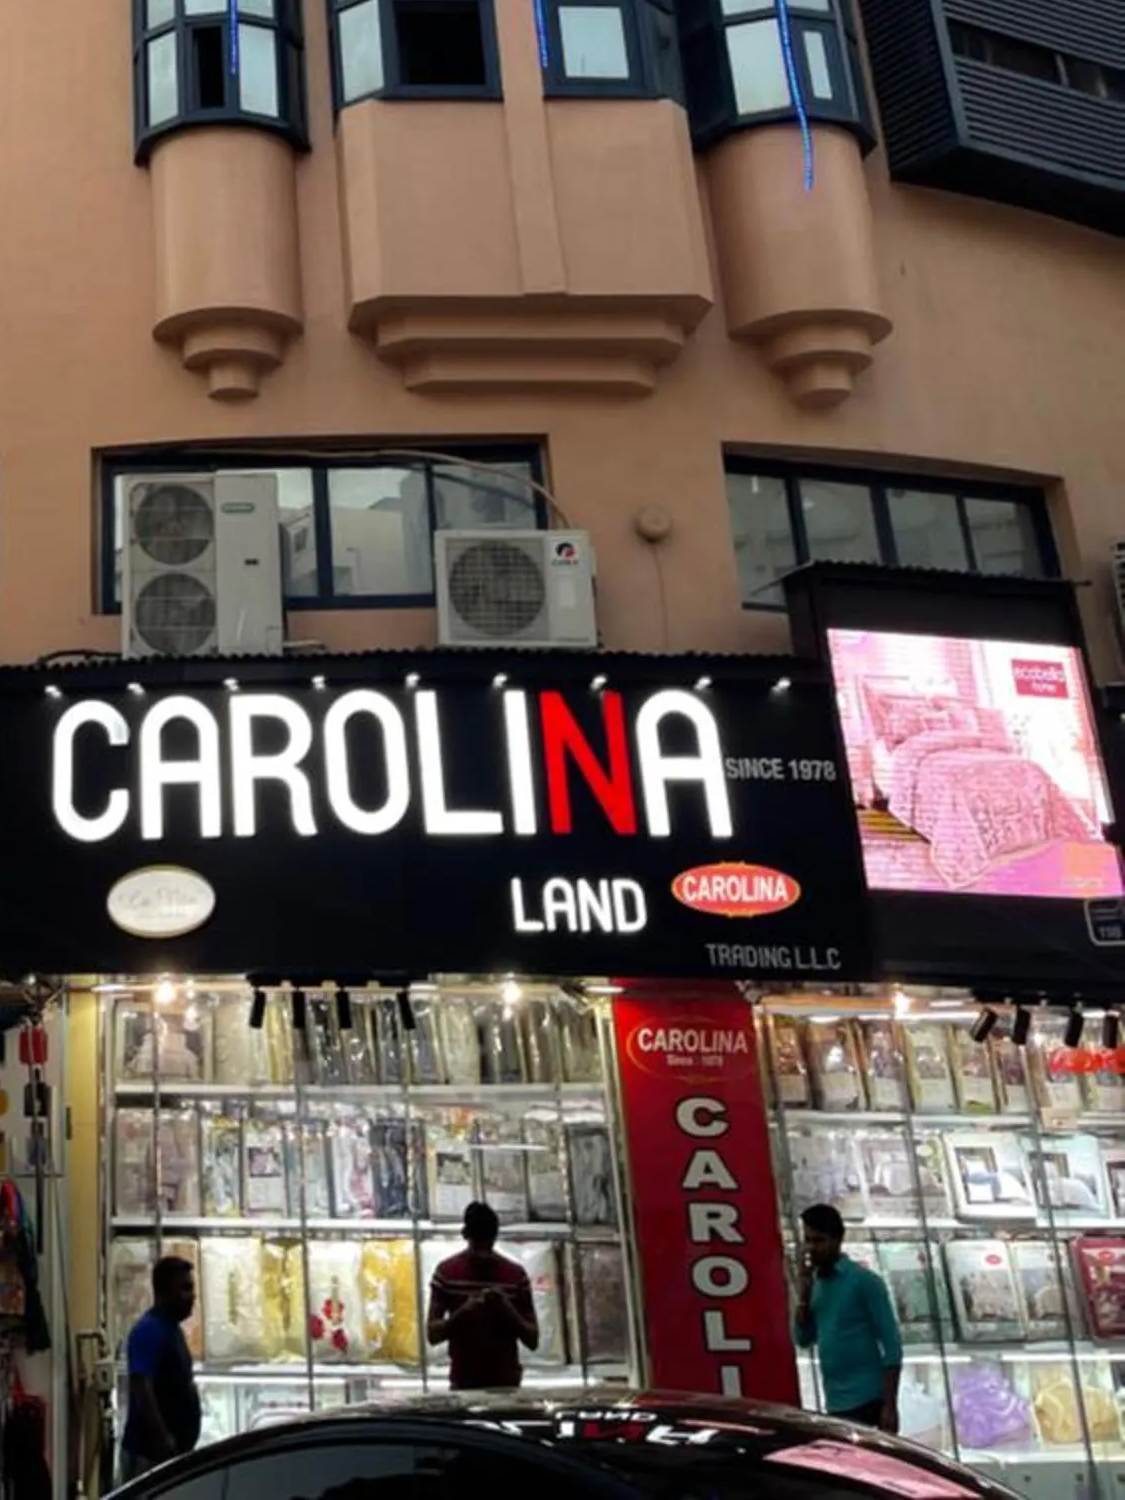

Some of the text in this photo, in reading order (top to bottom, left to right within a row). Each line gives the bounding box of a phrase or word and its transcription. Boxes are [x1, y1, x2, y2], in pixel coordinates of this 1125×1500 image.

[52, 689, 733, 841] CAROLINA
[726, 758, 836, 781] SINCE 1978
[682, 874, 789, 902] CAROLINA
[511, 877, 648, 934] LAND
[705, 943, 791, 969] TRADING
[638, 1027, 748, 1054] CAROLINA
